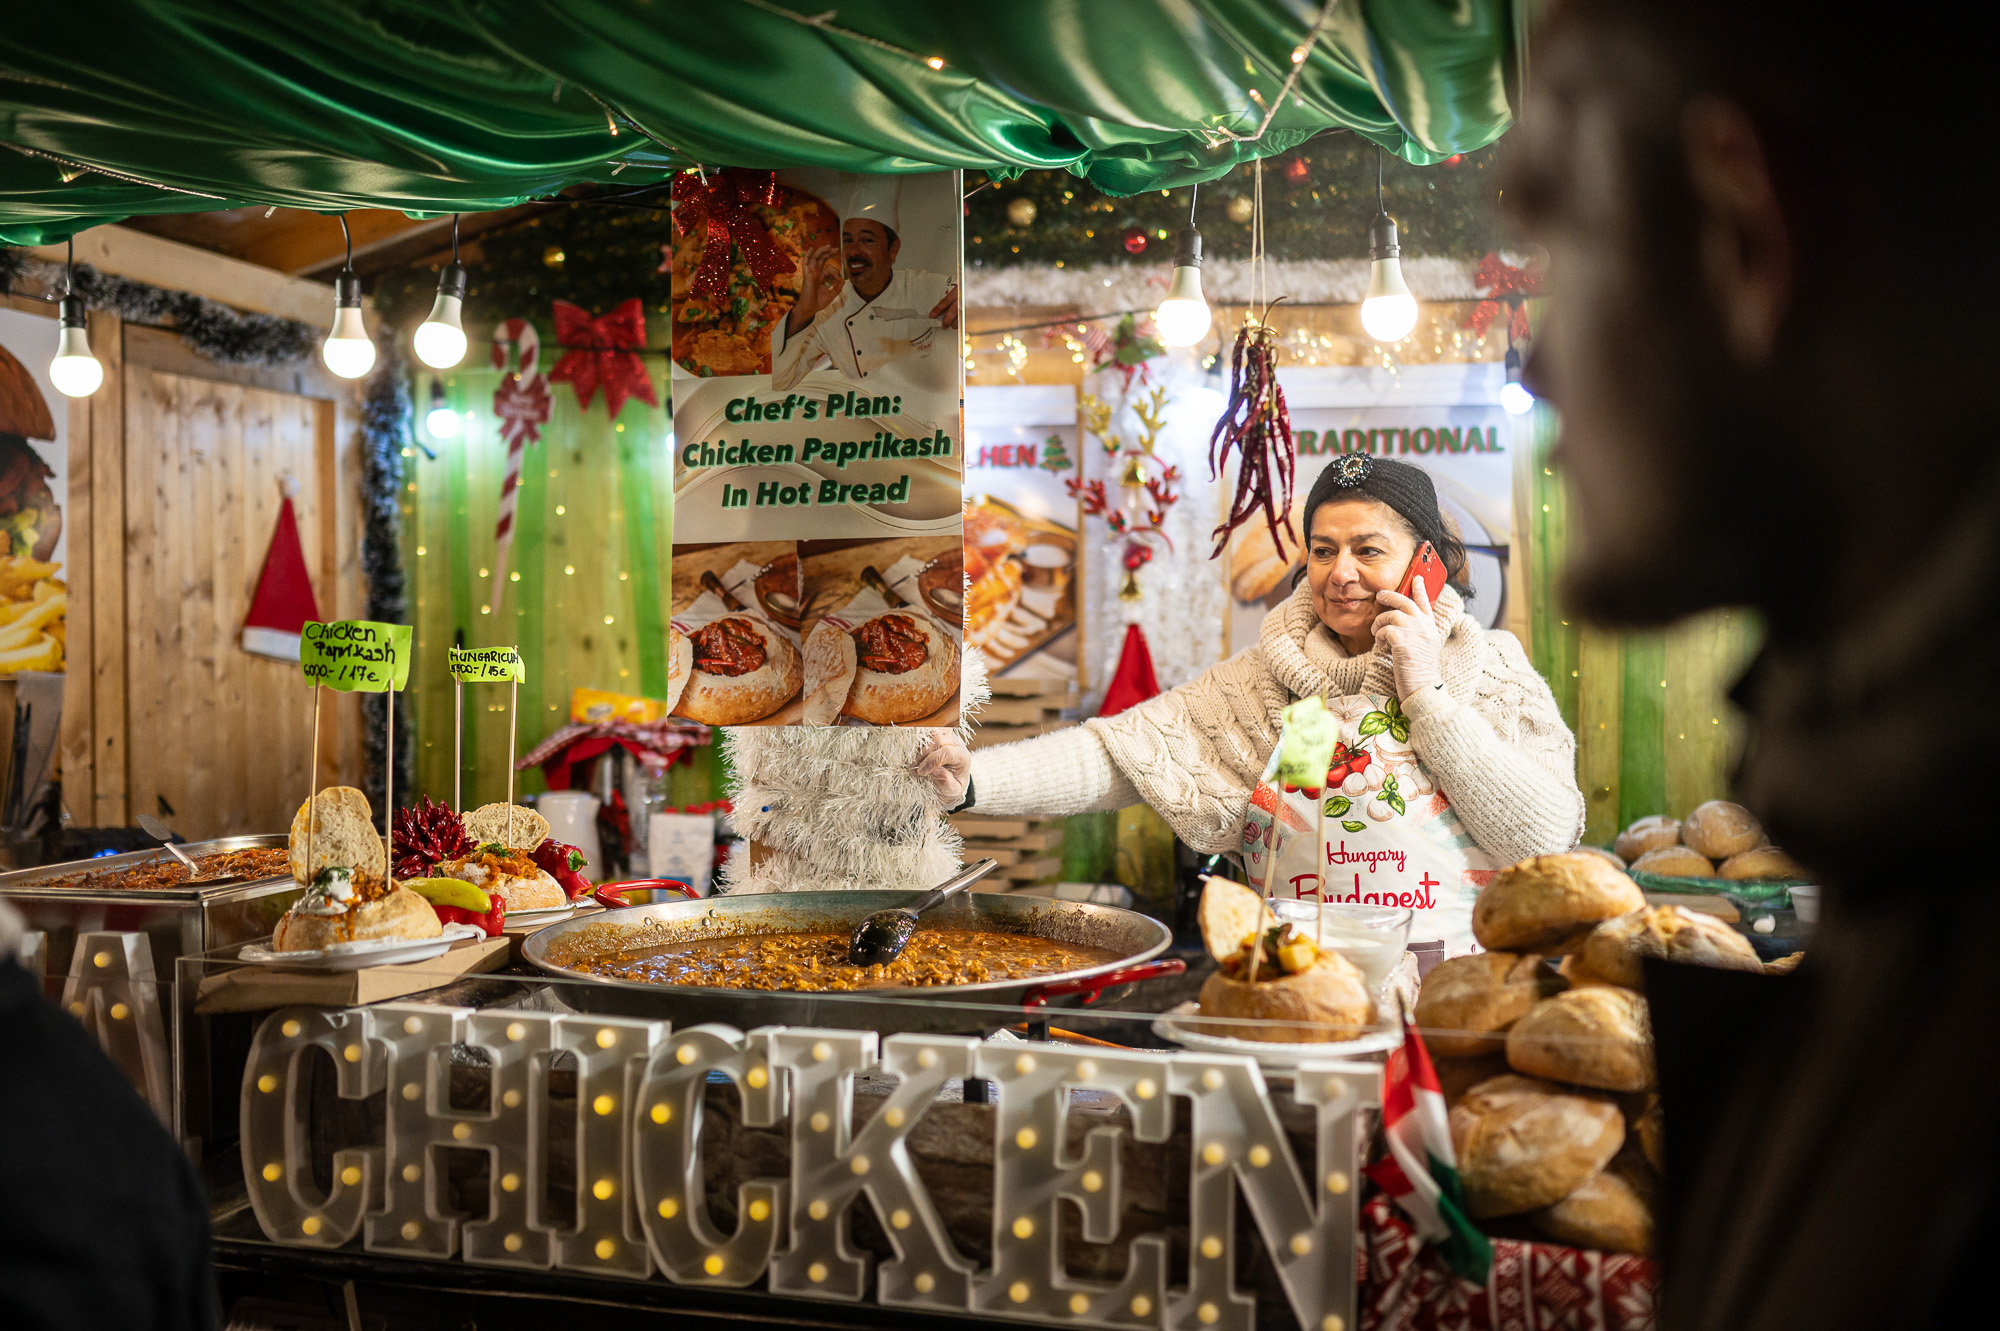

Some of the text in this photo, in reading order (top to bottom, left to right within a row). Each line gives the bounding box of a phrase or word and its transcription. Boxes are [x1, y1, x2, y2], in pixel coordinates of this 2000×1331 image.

[825, 391, 902, 420] Plan:
[682, 429, 952, 470] Chicken Paprikash
[969, 444, 1037, 468] HEN
[721, 475, 910, 510] In Hot Bread
[305, 623, 376, 642] Chicken
[313, 637, 396, 664] Paprikash
[1326, 840, 1407, 873] Hungary
[240, 1003, 1382, 1331] CHICKEN
